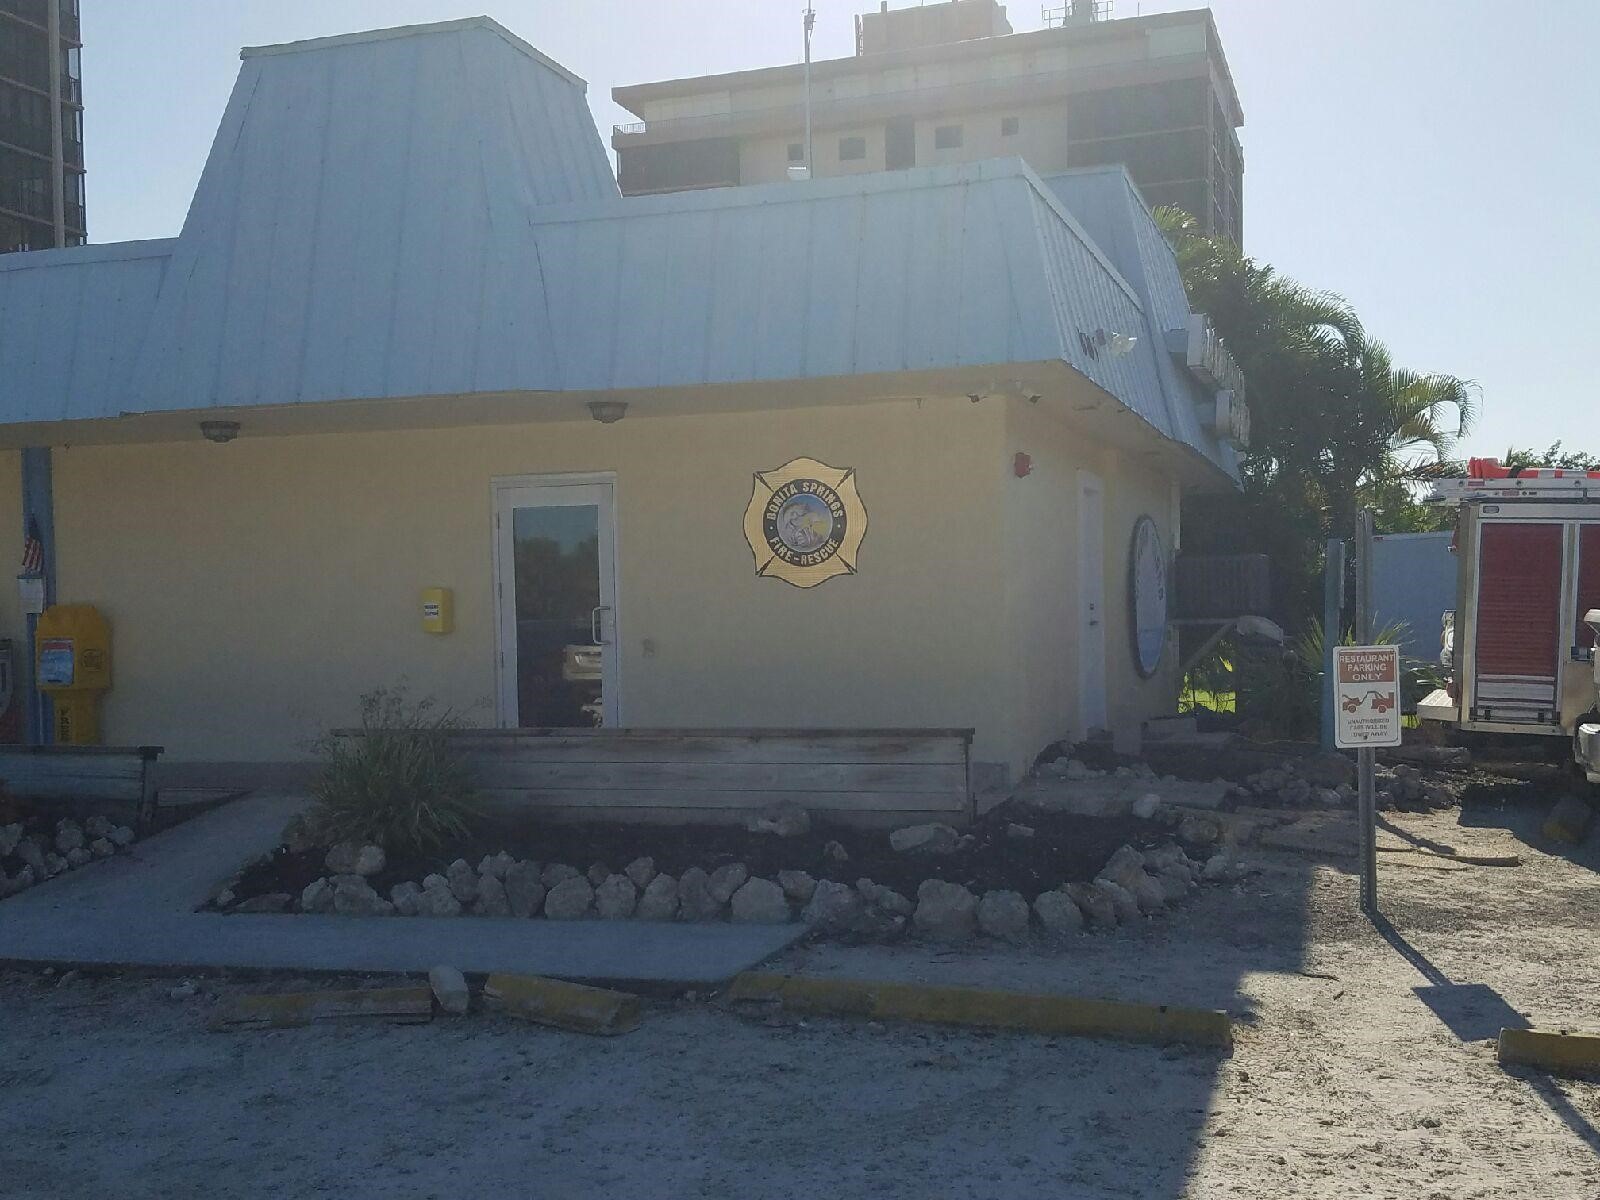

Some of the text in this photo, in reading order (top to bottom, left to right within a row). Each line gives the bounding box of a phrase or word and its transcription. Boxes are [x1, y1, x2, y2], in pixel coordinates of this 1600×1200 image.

[766, 482, 844, 521] BONITA SPRINGS
[1339, 654, 1395, 663] RESTAURANT
[1347, 663, 1387, 672] PARKING
[1352, 673, 1383, 681] ONLY
